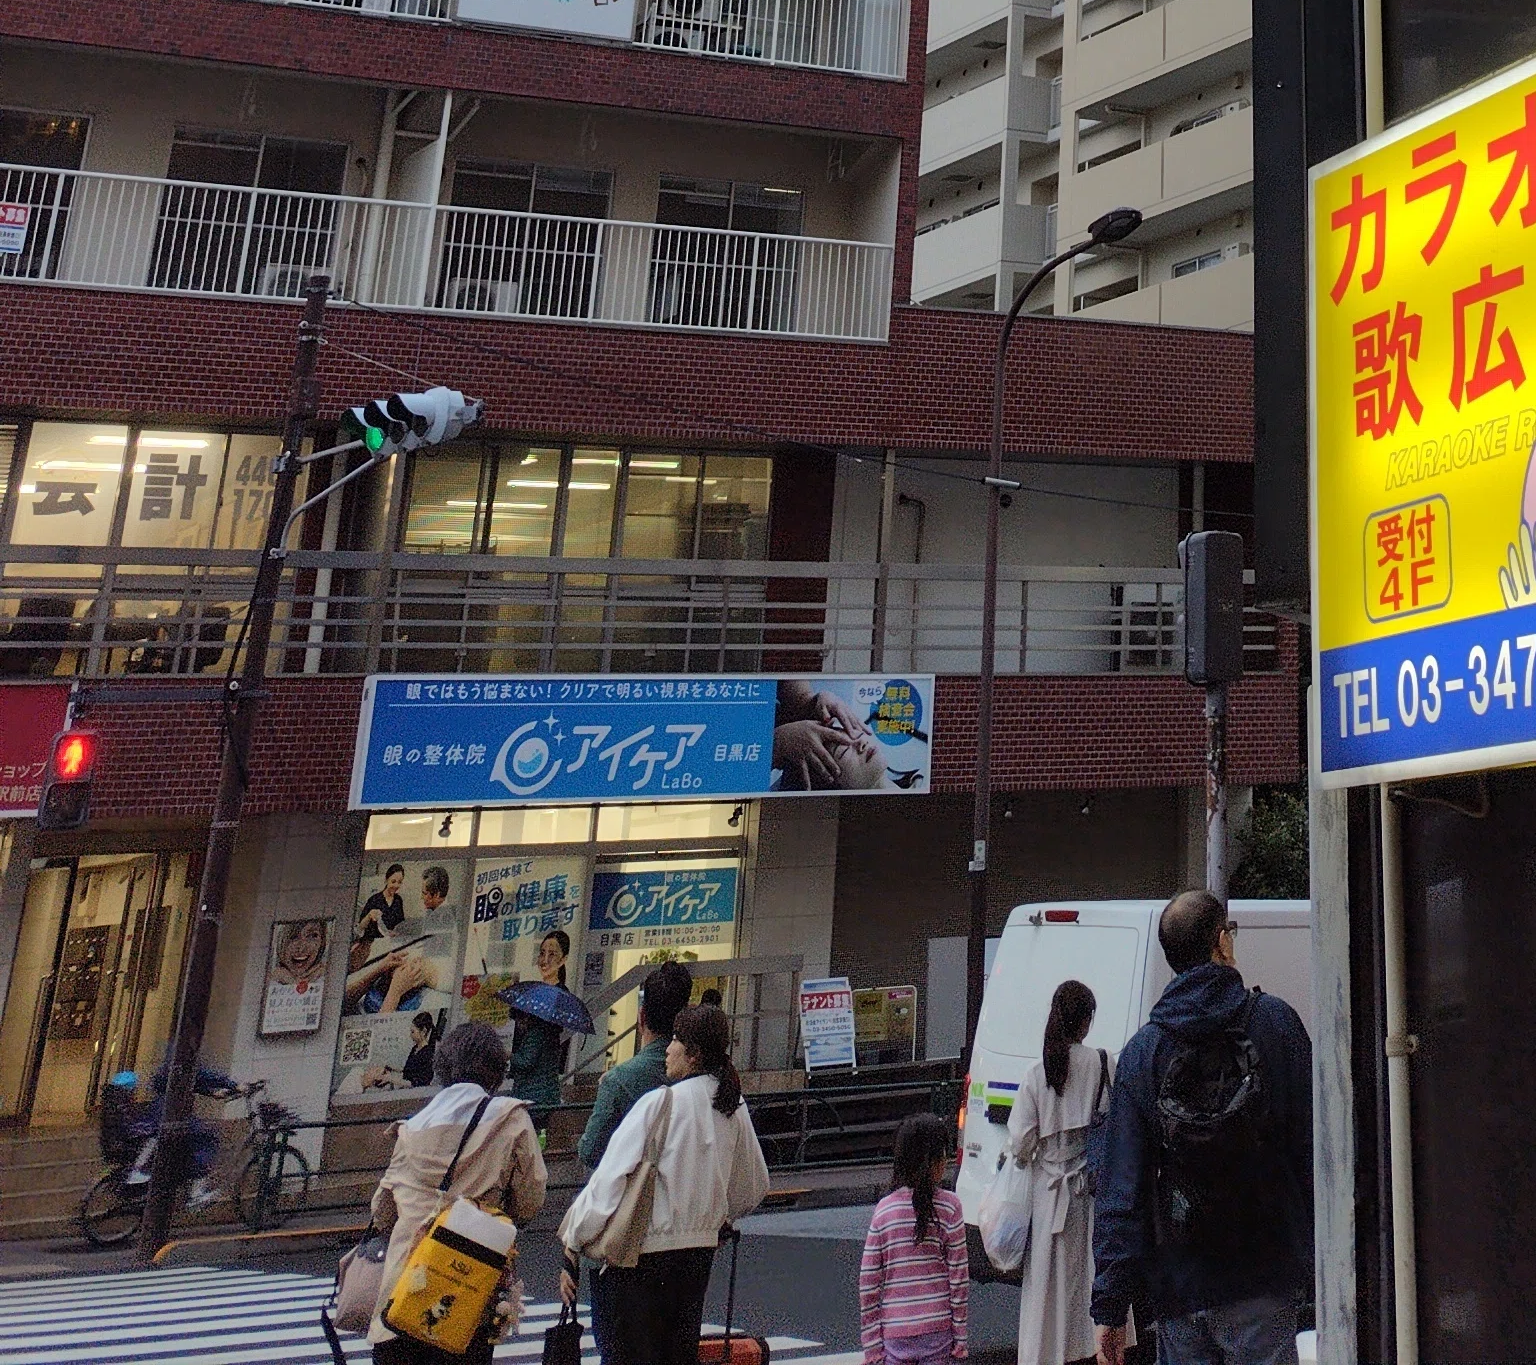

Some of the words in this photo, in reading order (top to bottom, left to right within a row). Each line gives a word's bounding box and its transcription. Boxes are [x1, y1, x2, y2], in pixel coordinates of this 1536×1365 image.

[1385, 415, 1509, 491] KARAOKE
[1376, 504, 1435, 567] 受付
[1379, 558, 1435, 611] 4F
[1333, 667, 1390, 738] TEL
[382, 743, 486, 766] 眼の整体院
[567, 724, 707, 790] アイケア
[714, 743, 761, 762] 目黒店
[661, 773, 702, 789] LaBo
[476, 861, 533, 886] 初回体験で
[474, 874, 580, 923] 眼の健康を
[645, 883, 721, 921] アイケア
[502, 903, 580, 942] 取り戻す
[601, 932, 635, 947] 目黒店
